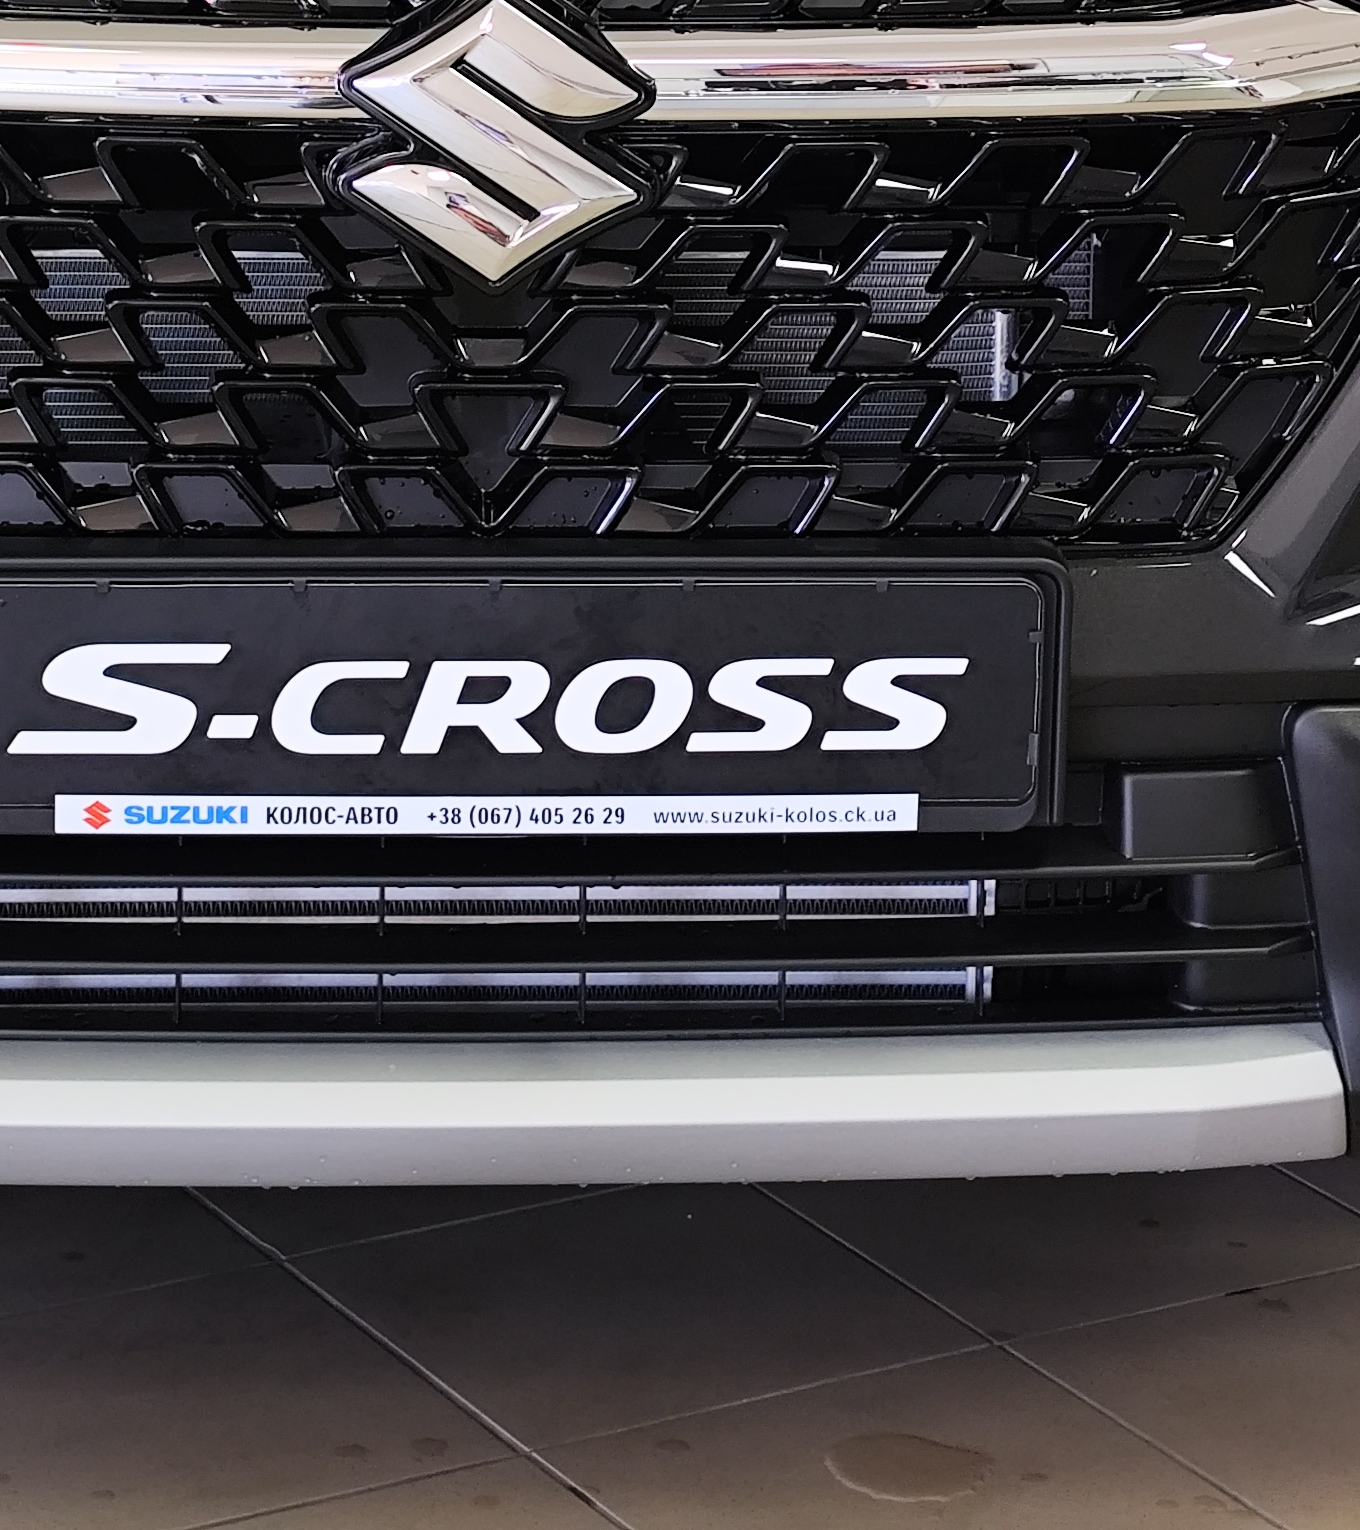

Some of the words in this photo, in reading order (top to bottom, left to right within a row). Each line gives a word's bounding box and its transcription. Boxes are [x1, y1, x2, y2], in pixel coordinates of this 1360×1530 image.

[6, 643, 970, 755] S-CROSS
[124, 805, 248, 825] SUZUKI
[266, 806, 399, 825] КОЛОС-АВТО
[427, 807, 462, 825] +38
[469, 805, 522, 829] (067)
[529, 807, 564, 825] 405
[572, 807, 595, 825] 26
[602, 807, 625, 825] 29
[653, 806, 897, 824] www.suzuki-kolos.ck.ua
